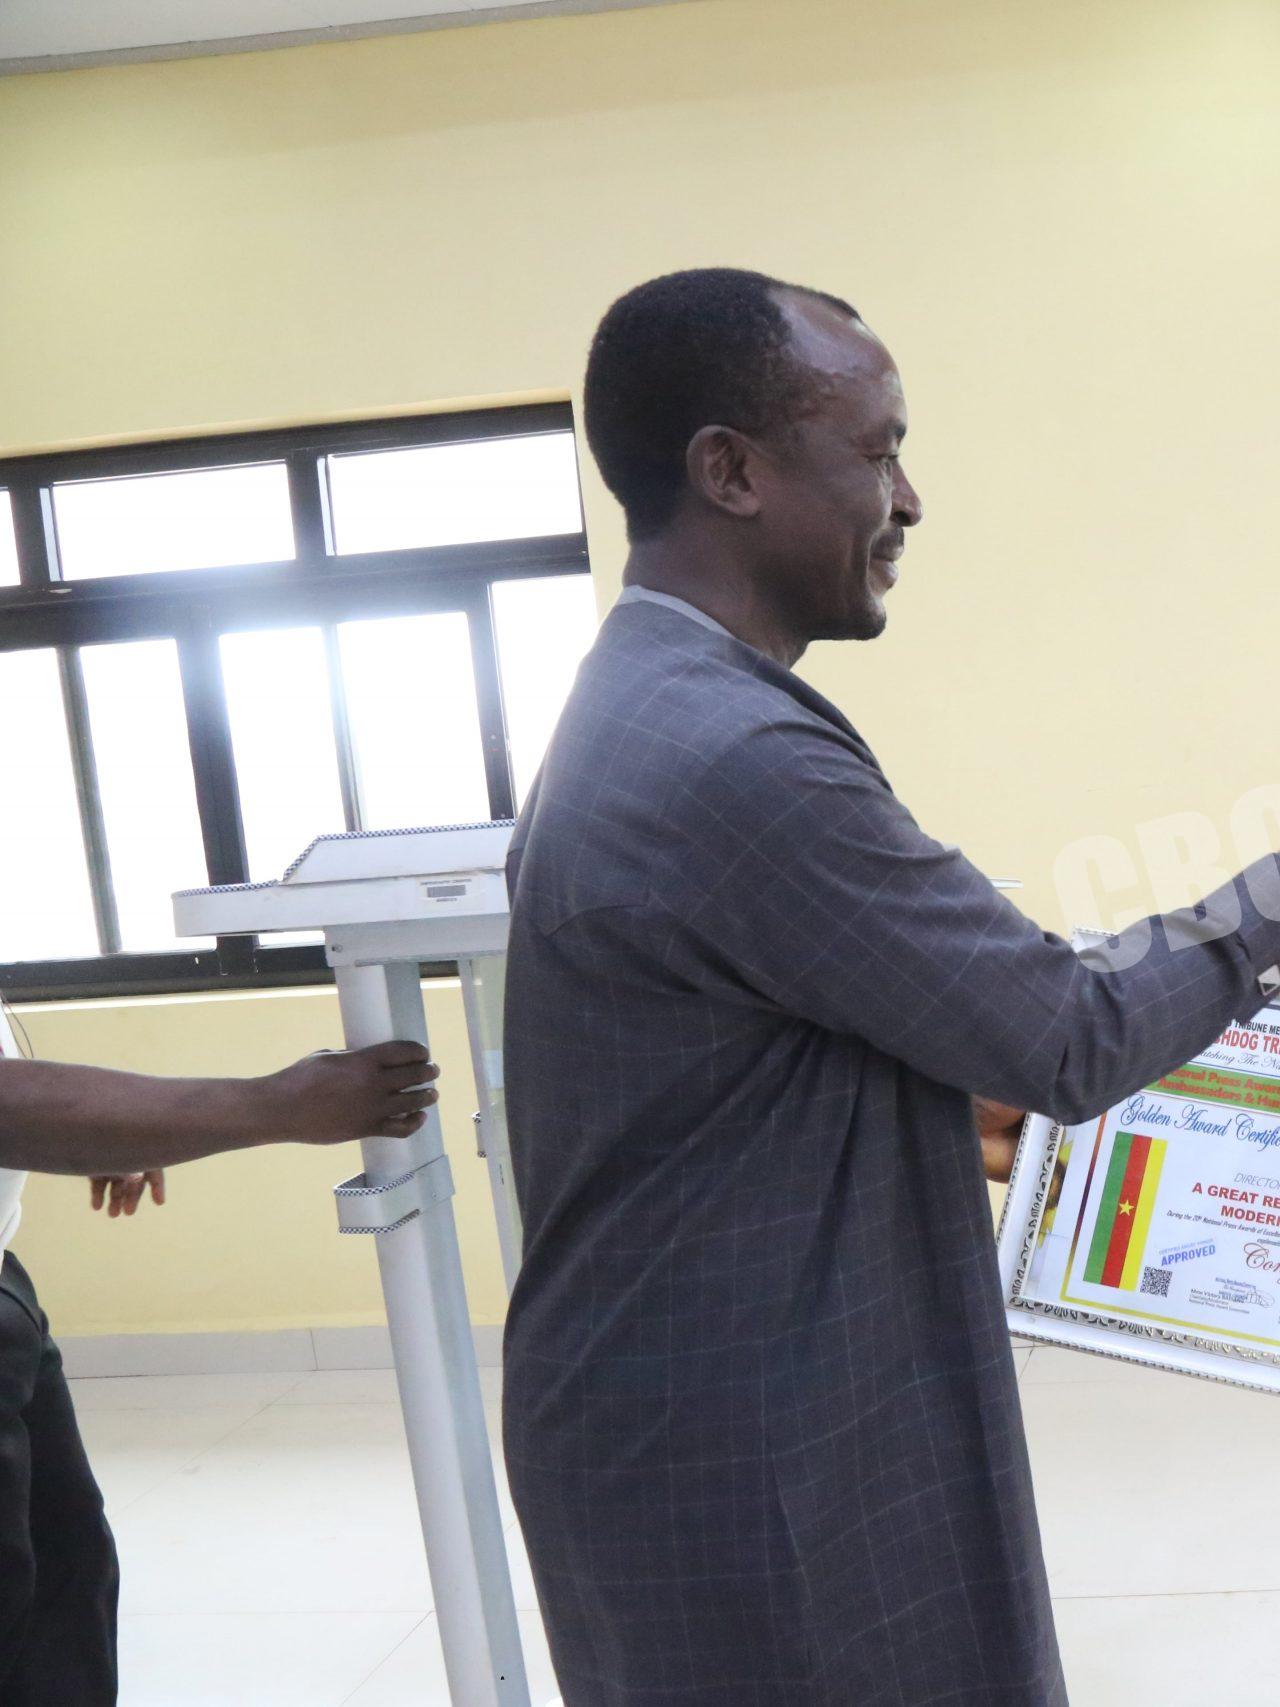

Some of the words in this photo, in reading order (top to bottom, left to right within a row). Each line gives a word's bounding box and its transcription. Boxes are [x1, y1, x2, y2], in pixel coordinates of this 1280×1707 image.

[1120, 1094, 1171, 1126] Golden
[1174, 1104, 1232, 1137] Award
[1192, 1182, 1203, 1194] A
[1207, 1185, 1259, 1204] GREAT
[1161, 1245, 1216, 1267] APPROVED
